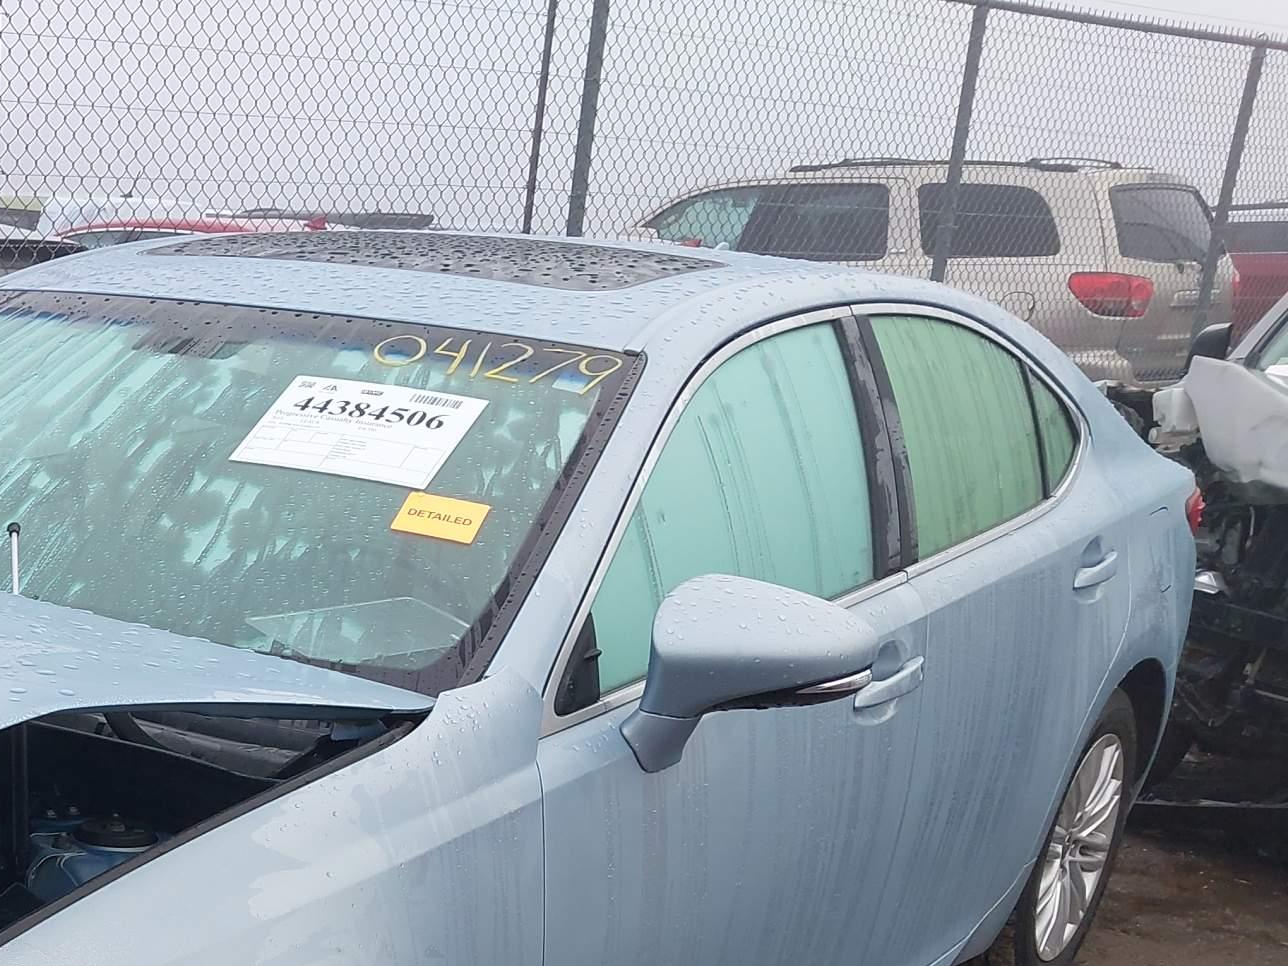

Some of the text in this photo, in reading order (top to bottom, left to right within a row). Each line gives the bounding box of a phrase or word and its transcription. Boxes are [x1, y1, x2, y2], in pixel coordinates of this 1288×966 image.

[373, 335, 623, 395] 041279
[293, 396, 452, 431] 44384506
[407, 508, 472, 526] DETAILED
